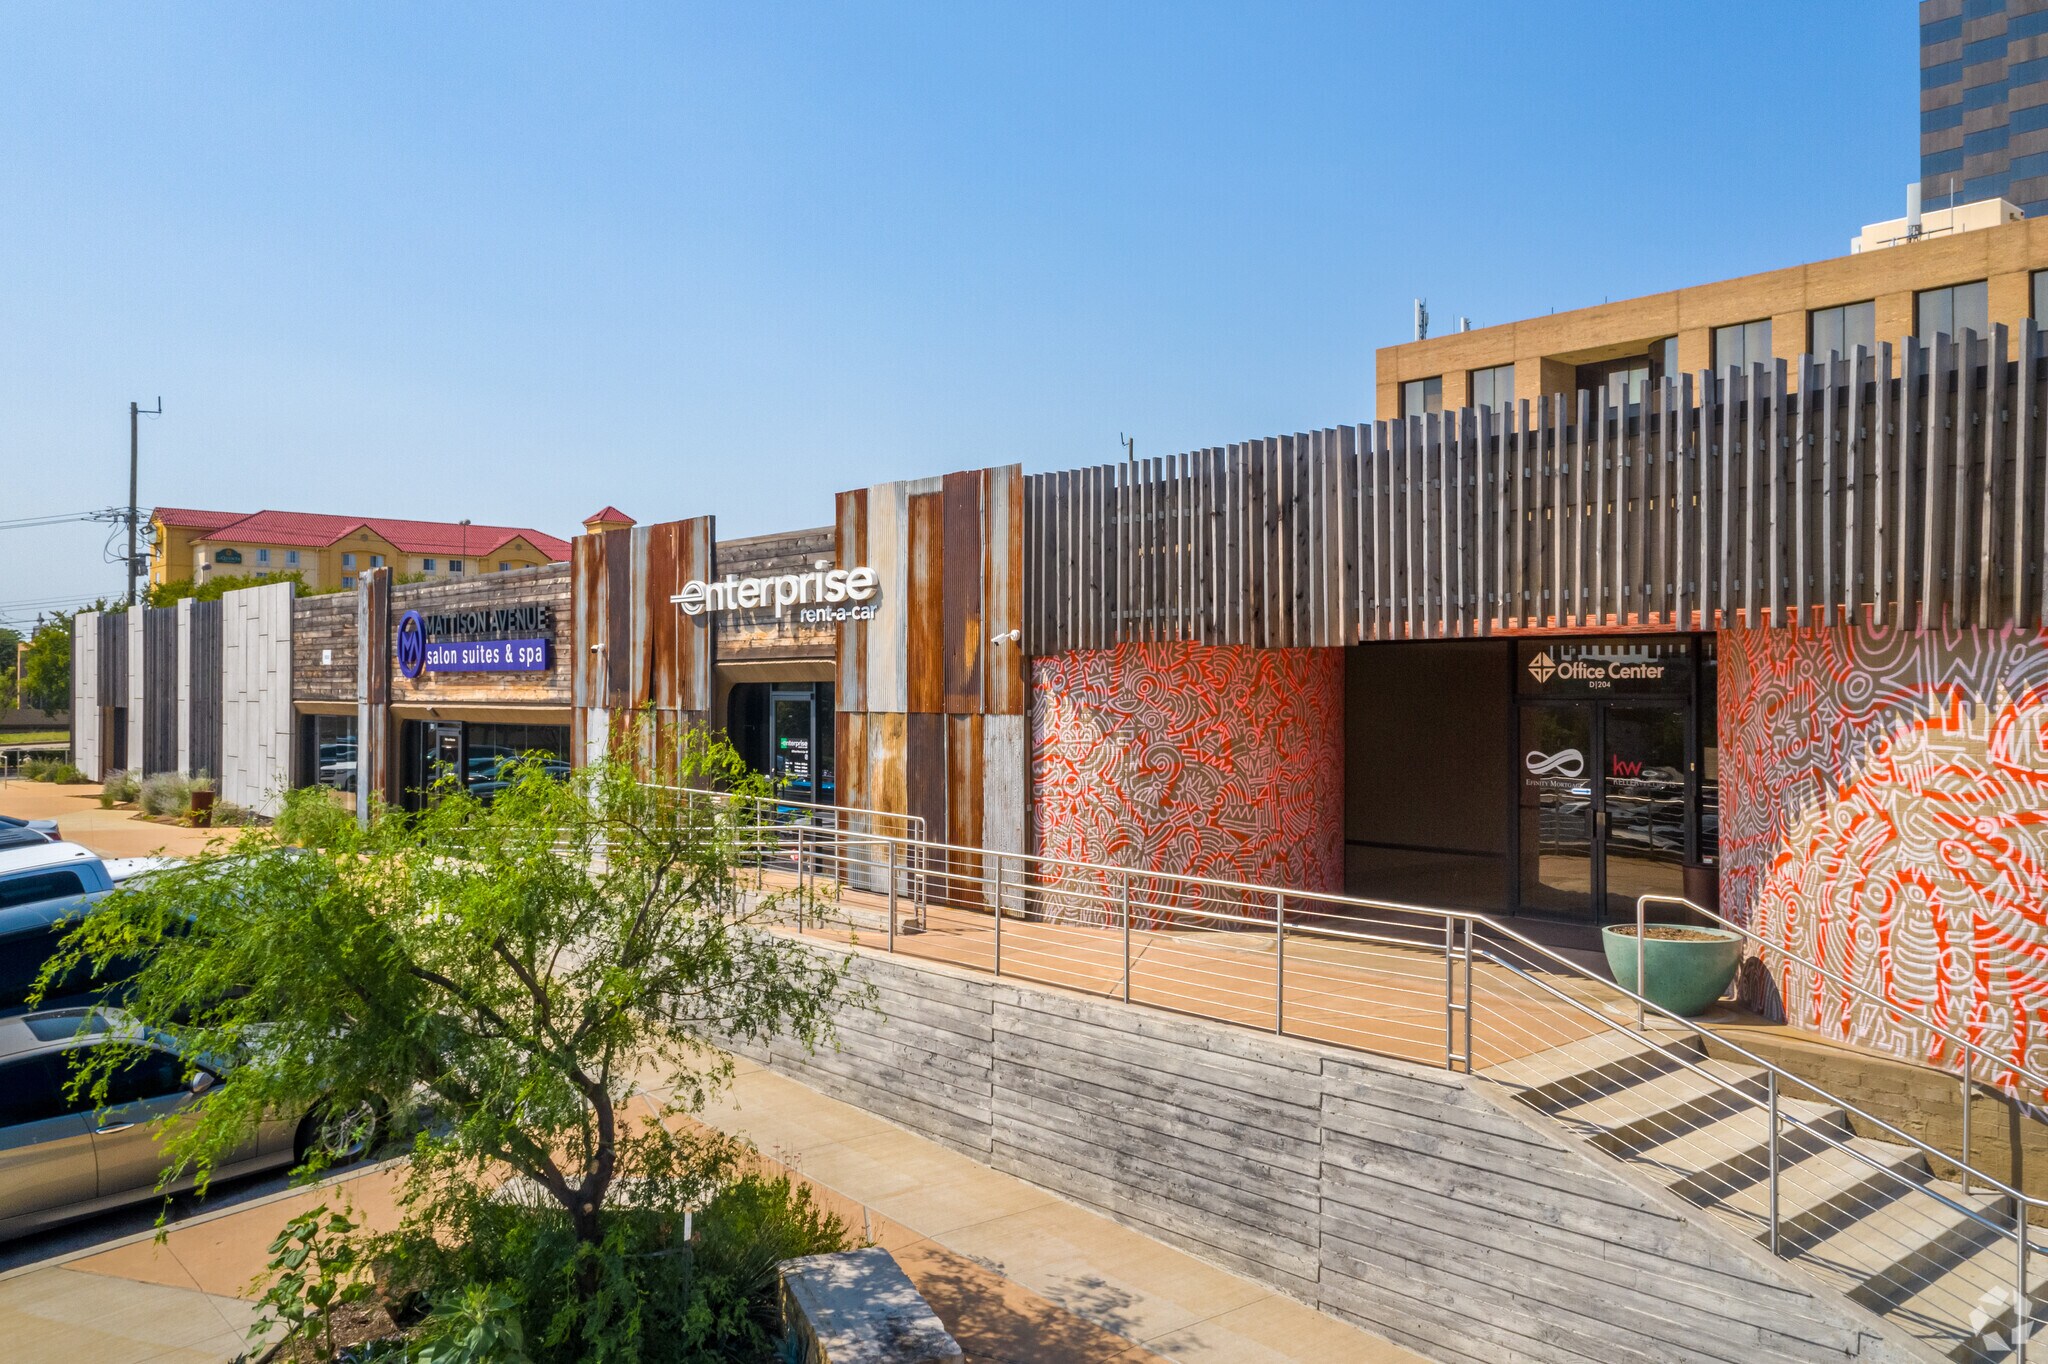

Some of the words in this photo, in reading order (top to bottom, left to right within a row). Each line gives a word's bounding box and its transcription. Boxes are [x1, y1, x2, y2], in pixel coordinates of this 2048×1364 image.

[670, 560, 879, 618] enterprise
[425, 611, 489, 635] MATTISON
[490, 606, 547, 632] AVENUE
[800, 604, 878, 623] rent-a-car
[427, 646, 457, 665] salon
[462, 645, 500, 664] suites
[505, 643, 514, 663] &
[518, 646, 543, 667] spa
[1557, 662, 1605, 679] Office
[1608, 662, 1664, 679] Center
[1613, 753, 1643, 776] kw
